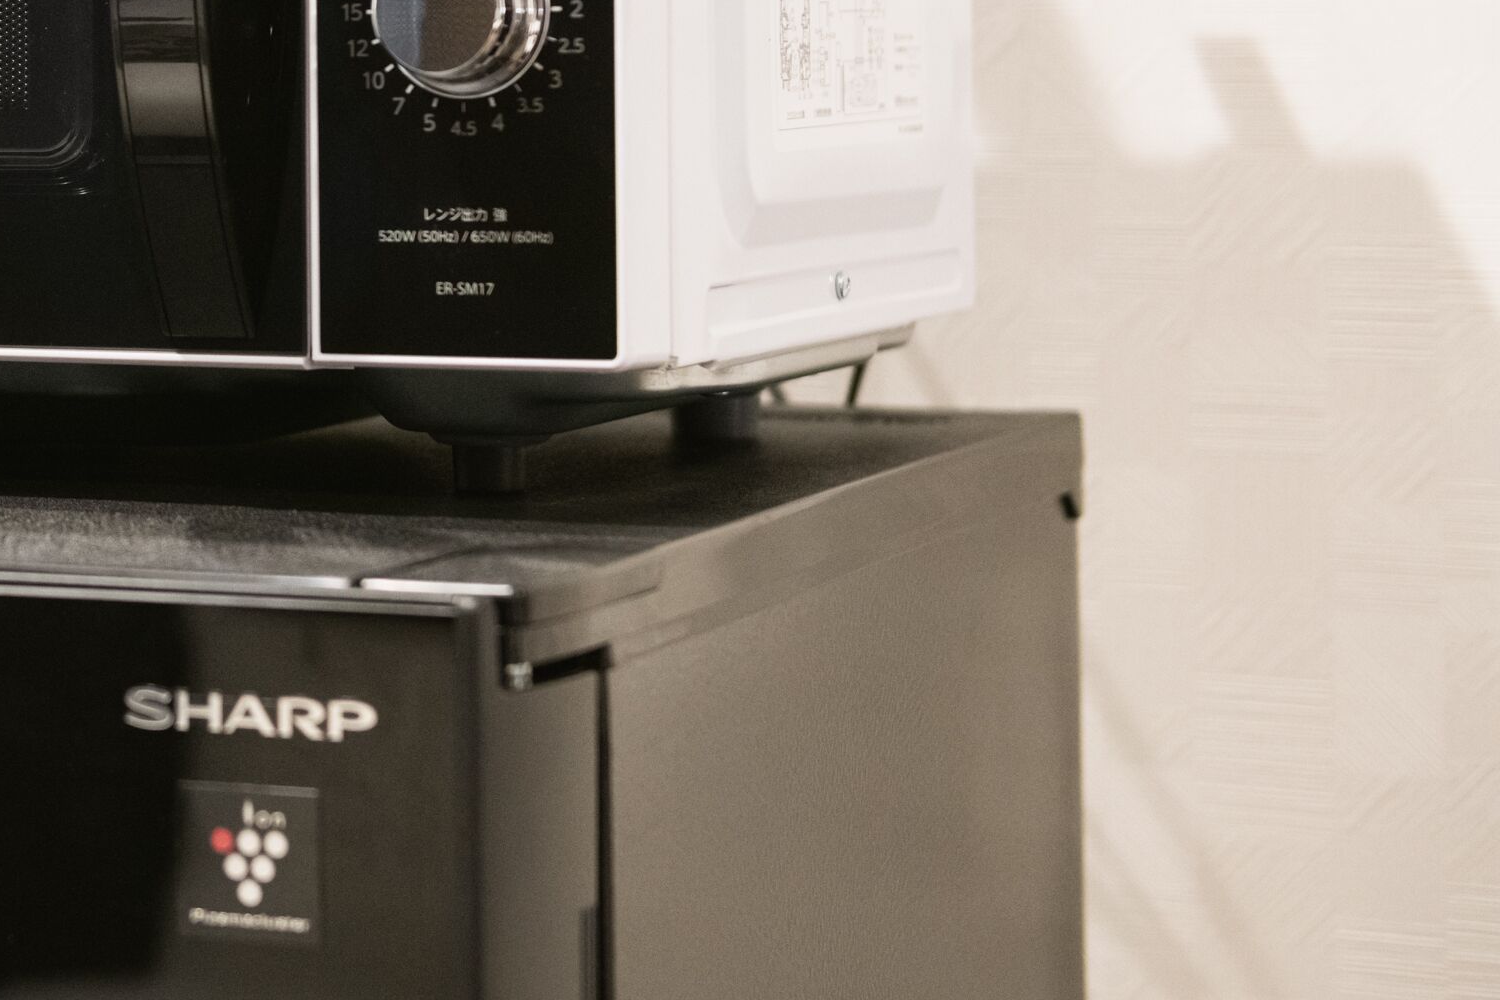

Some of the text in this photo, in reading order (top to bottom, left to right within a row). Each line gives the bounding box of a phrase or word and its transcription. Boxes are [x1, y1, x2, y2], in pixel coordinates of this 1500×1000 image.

[343, 4, 363, 21] 15
[570, 0, 583, 17] 2
[348, 40, 368, 57] 12
[559, 37, 585, 54] 2.5
[363, 73, 384, 90] 10
[549, 71, 563, 88] 3
[392, 98, 405, 115] 7
[518, 98, 544, 114] 3.5
[424, 114, 436, 131] 5
[451, 120, 477, 136] 4.5
[492, 113, 505, 131] 4
[423, 207, 508, 222] レンジ出力 強
[378, 230, 417, 243] 520W
[417, 230, 460, 244] (50Hz)
[470, 230, 511, 244] 650W
[511, 231, 555, 245] (60Hz)
[435, 281, 495, 296] ER-SM17
[123, 684, 379, 743] SHARP
